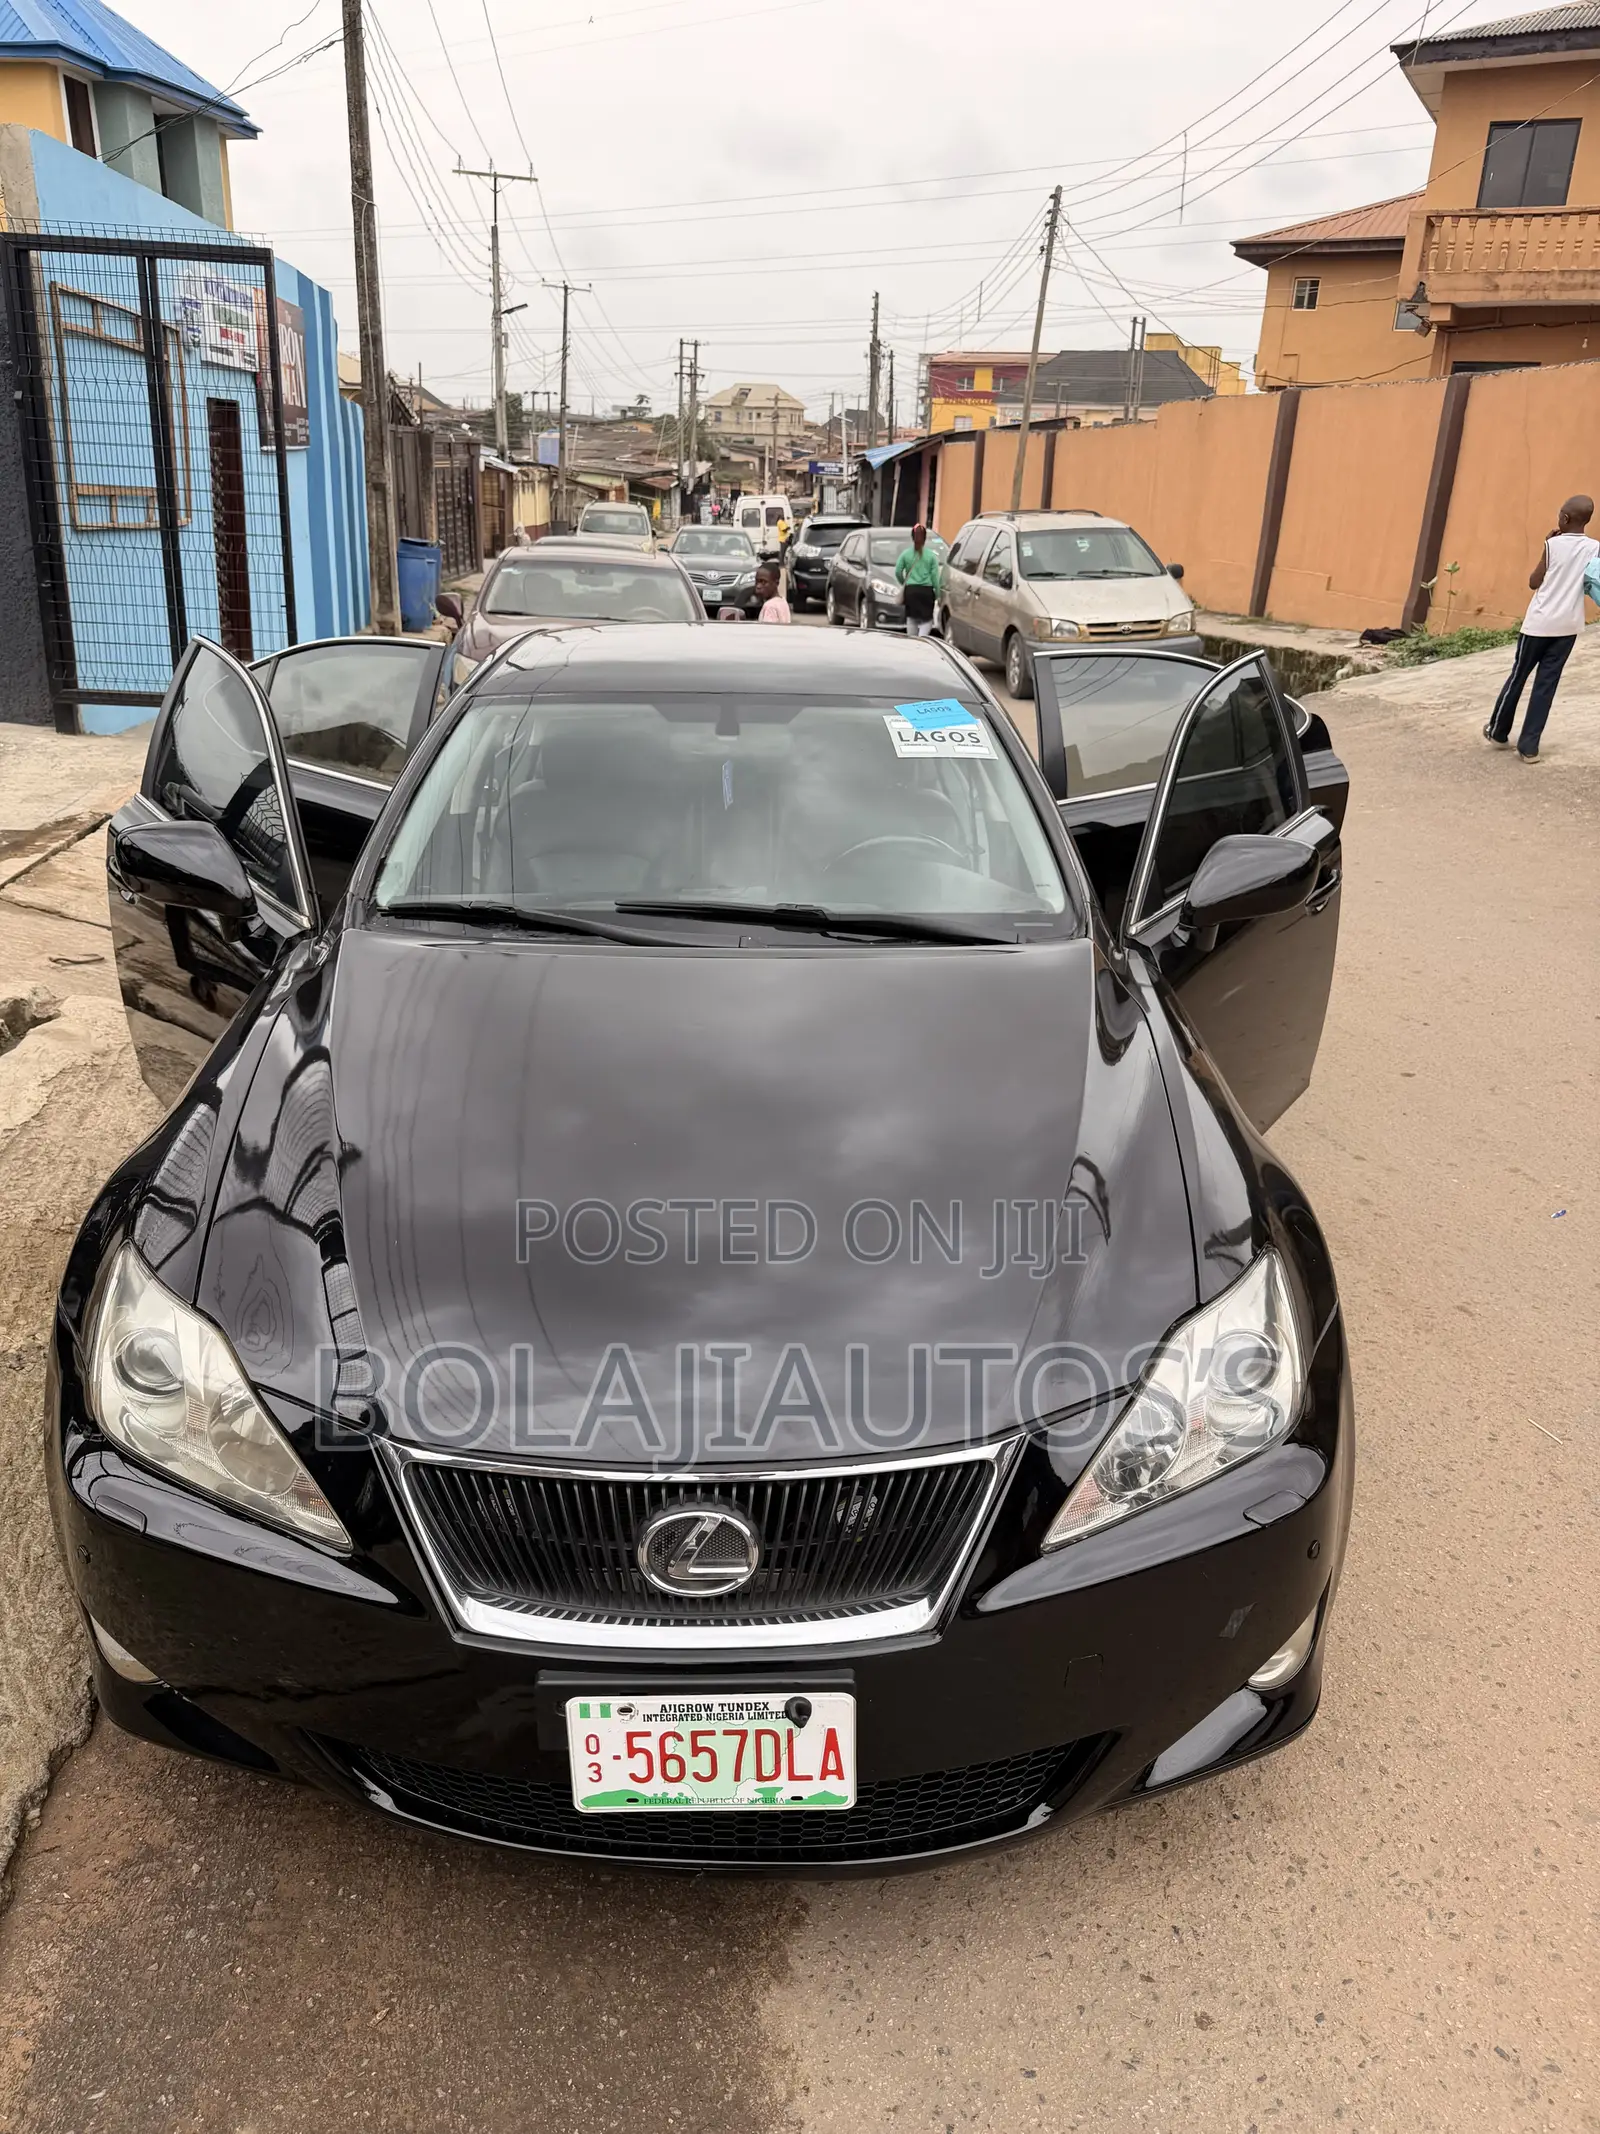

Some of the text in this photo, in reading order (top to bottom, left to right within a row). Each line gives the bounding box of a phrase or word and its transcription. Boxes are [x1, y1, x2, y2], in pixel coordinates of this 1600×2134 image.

[916, 706, 952, 715] LAGOS
[896, 730, 981, 744] LAGOS
[660, 1702, 770, 1713] AJIGROW TUNDEX
[642, 1713, 703, 1722] INTEGRATED
[706, 1712, 745, 1721] NIGERIA
[643, 1796, 785, 1806] FEDERAL REPUBLIC OF NIGERIA
